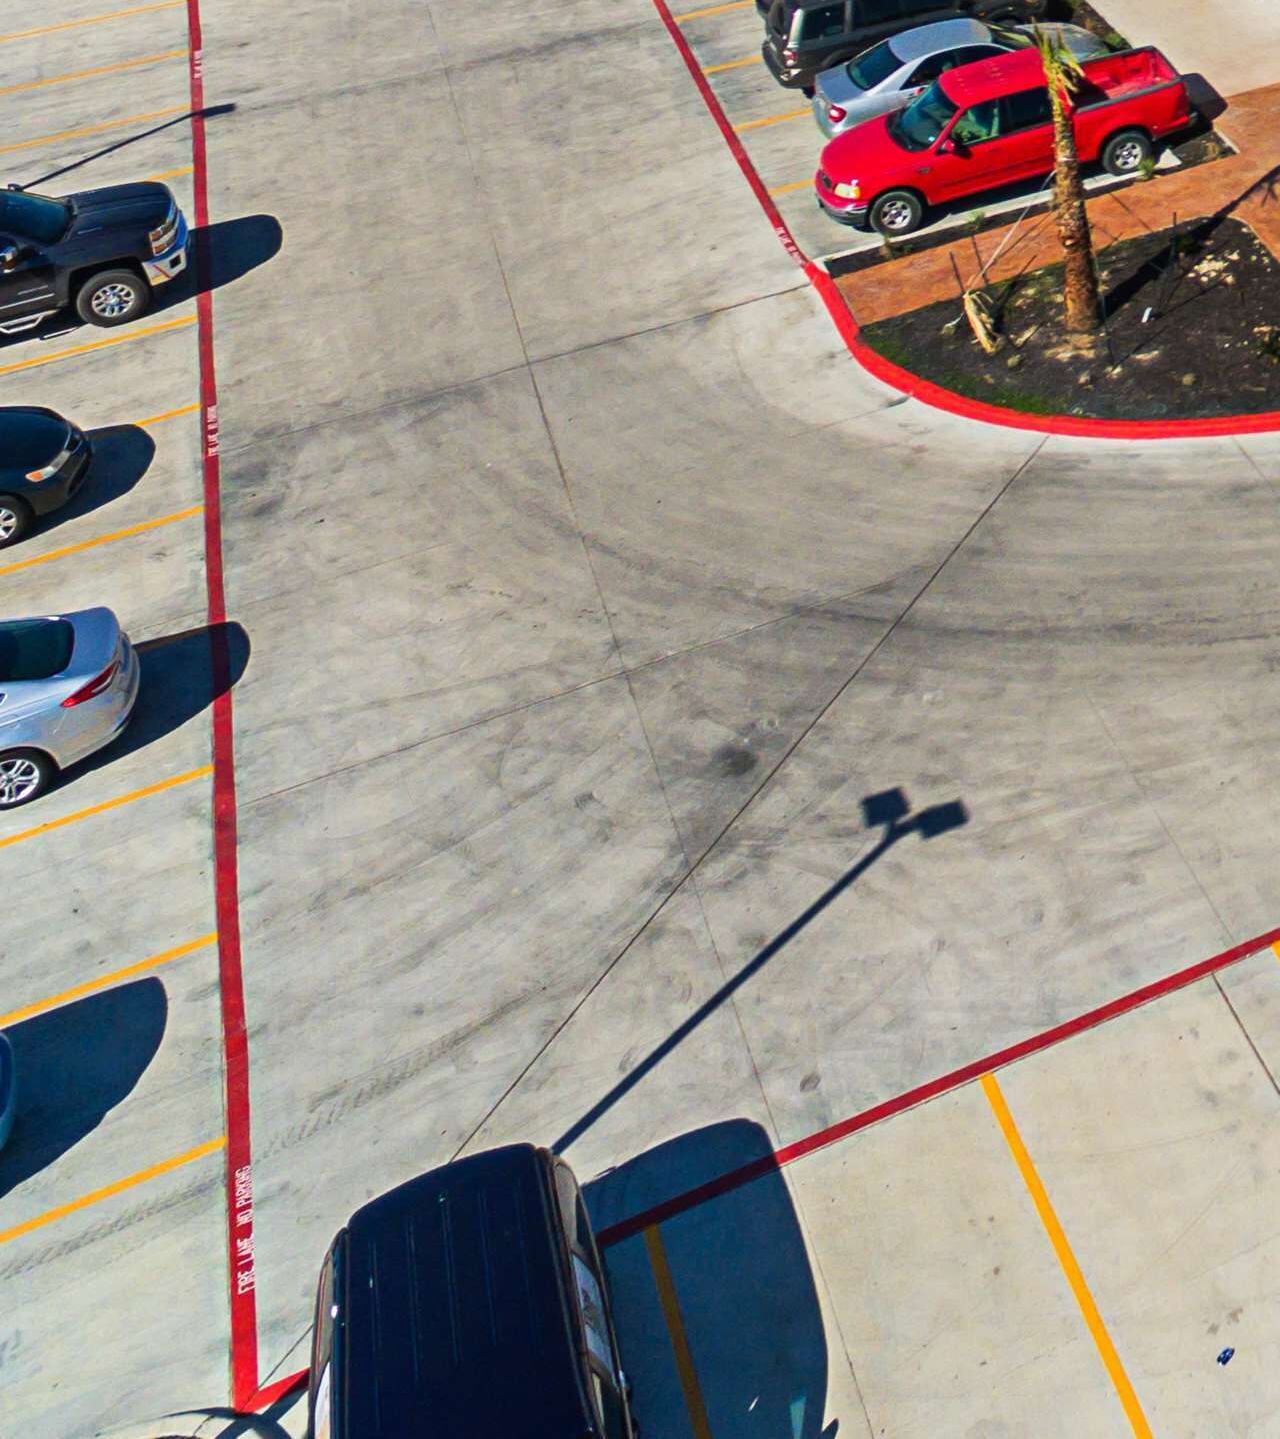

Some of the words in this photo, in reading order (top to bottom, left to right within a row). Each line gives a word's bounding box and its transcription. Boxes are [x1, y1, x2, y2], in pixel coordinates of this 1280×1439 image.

[235, 1165, 253, 1208] PARKING
[236, 1208, 254, 1227] NO
[237, 1234, 255, 1265] LANE
[237, 1265, 256, 1295] FIRE
